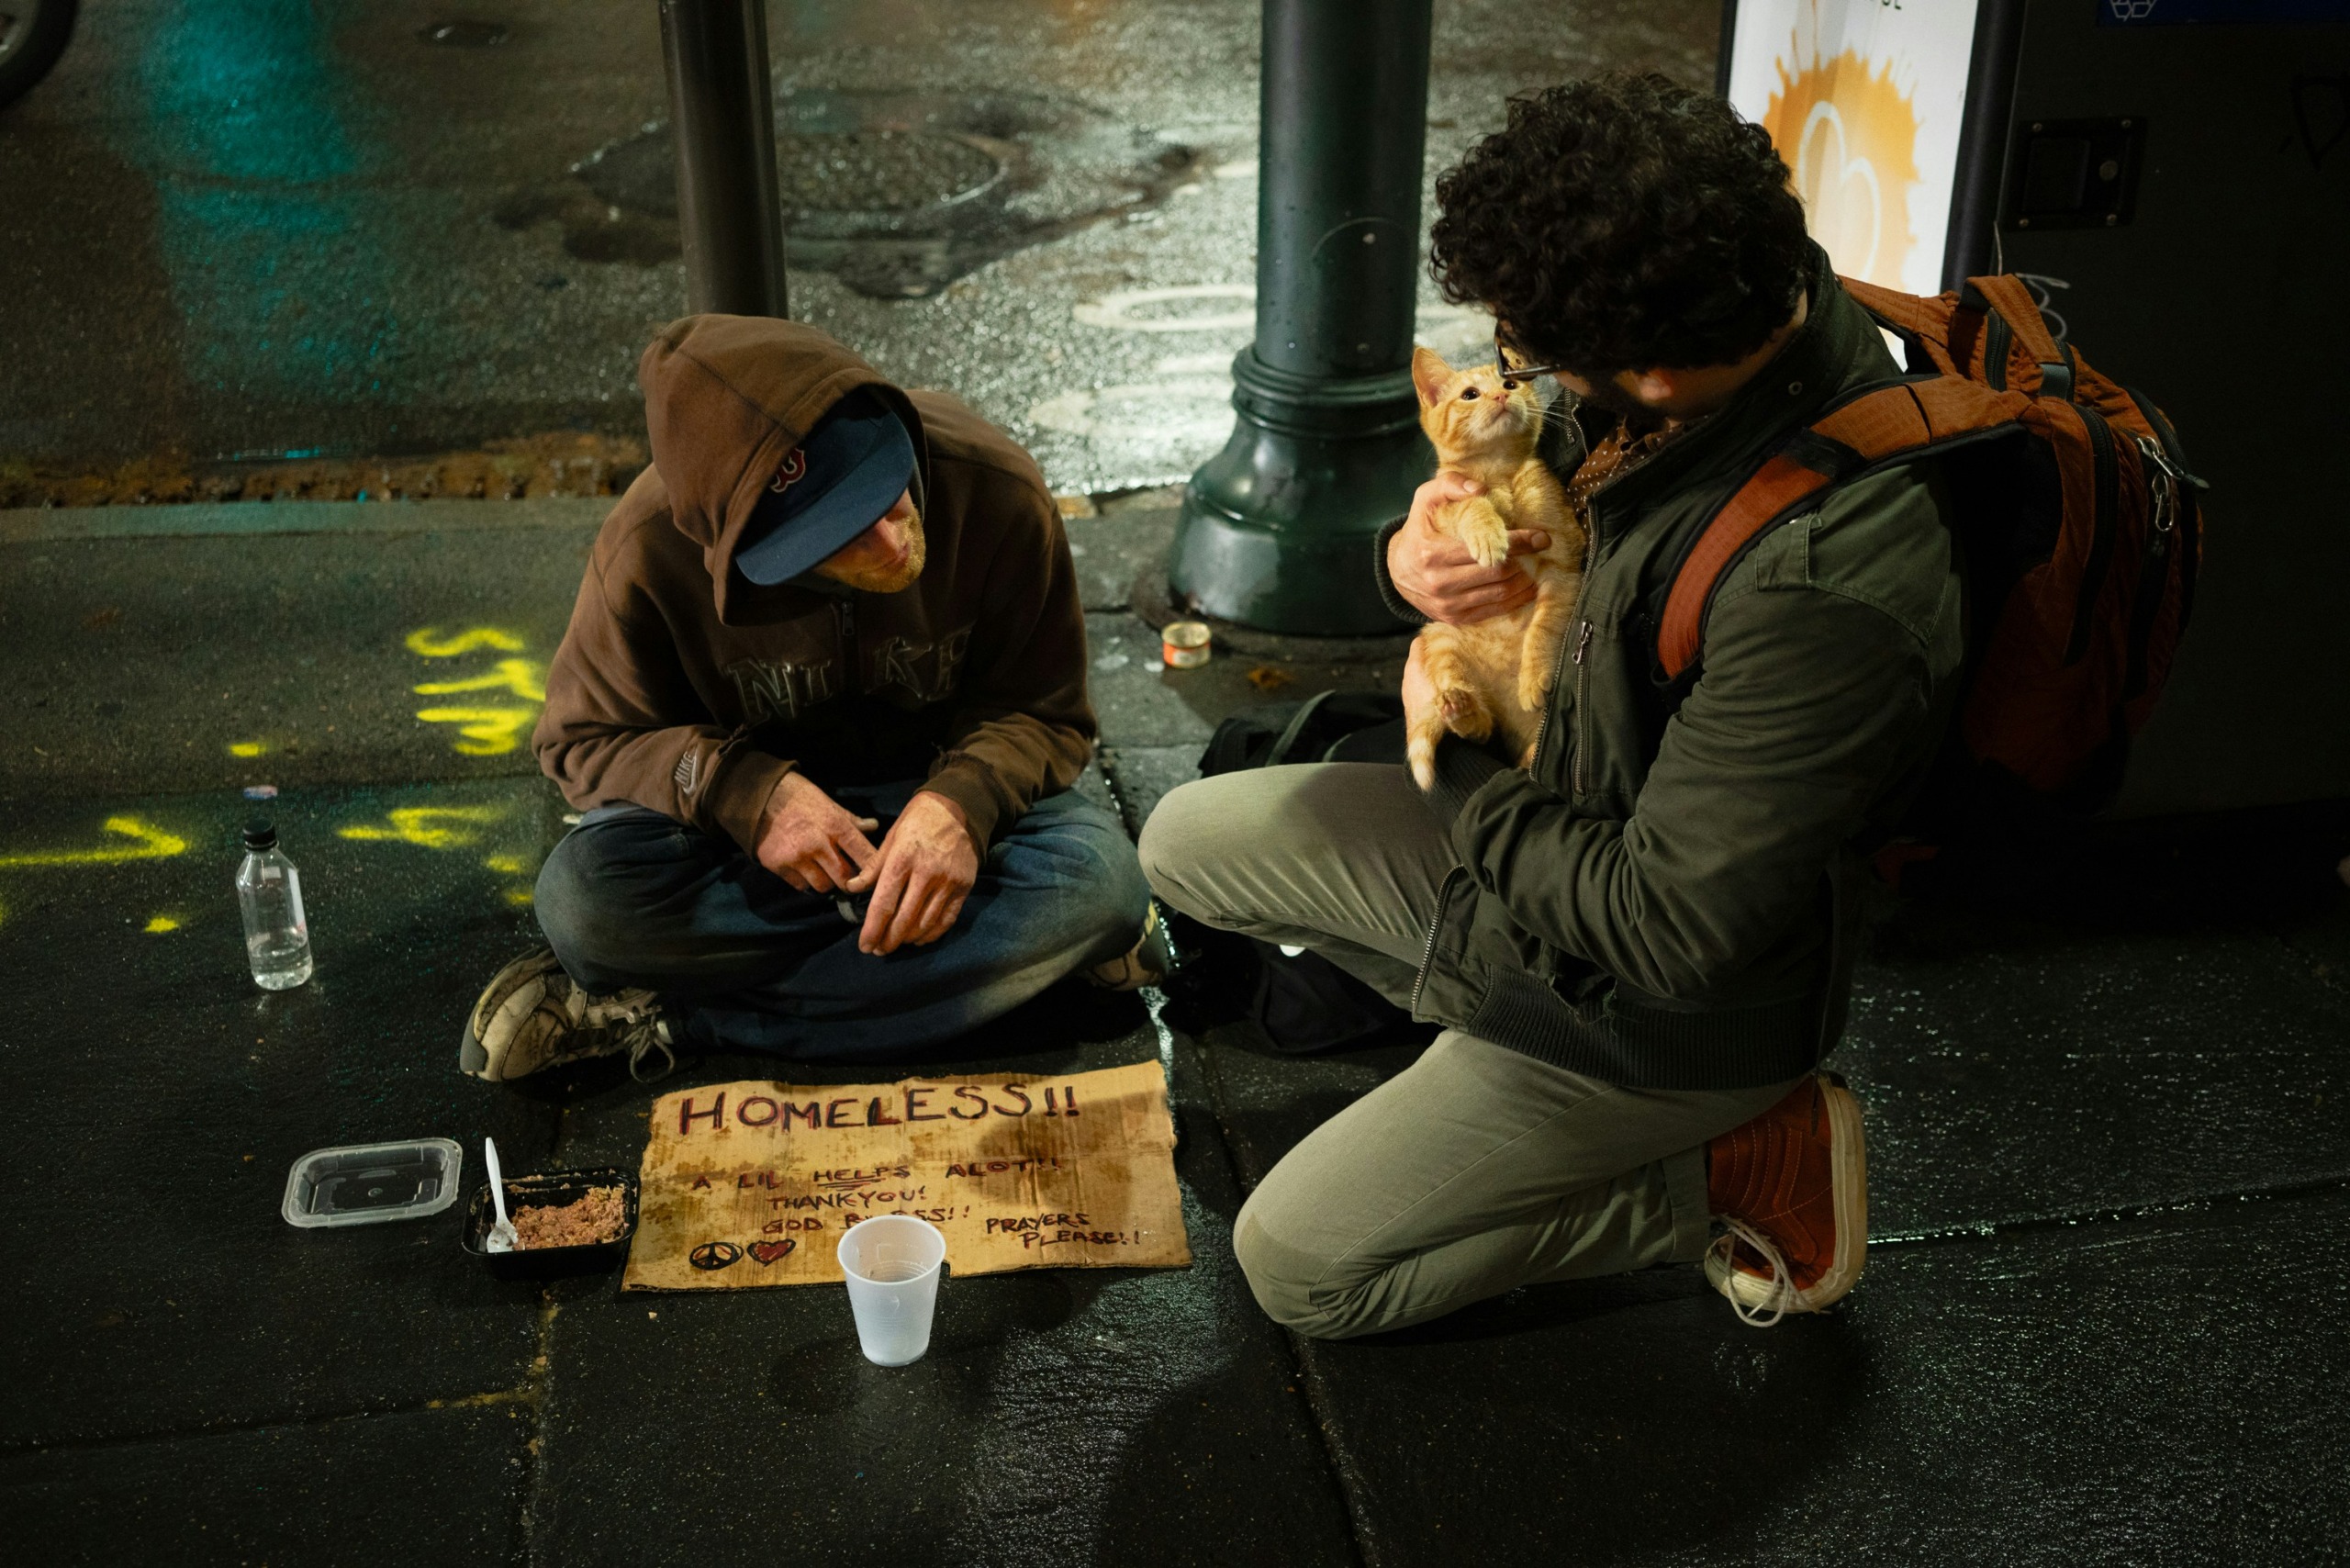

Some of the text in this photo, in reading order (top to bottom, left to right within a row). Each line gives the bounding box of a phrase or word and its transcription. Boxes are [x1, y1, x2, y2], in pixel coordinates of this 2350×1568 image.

[679, 1081, 1080, 1136] HOMELESS!!
[690, 1174, 711, 1191] A
[737, 1170, 784, 1190] LIL
[813, 1164, 911, 1182] HELPS
[762, 1204, 970, 1235] GOD BSS!!
[986, 1212, 1091, 1235] PRAYERS
[1019, 1230, 1141, 1249] PLEASE!!
